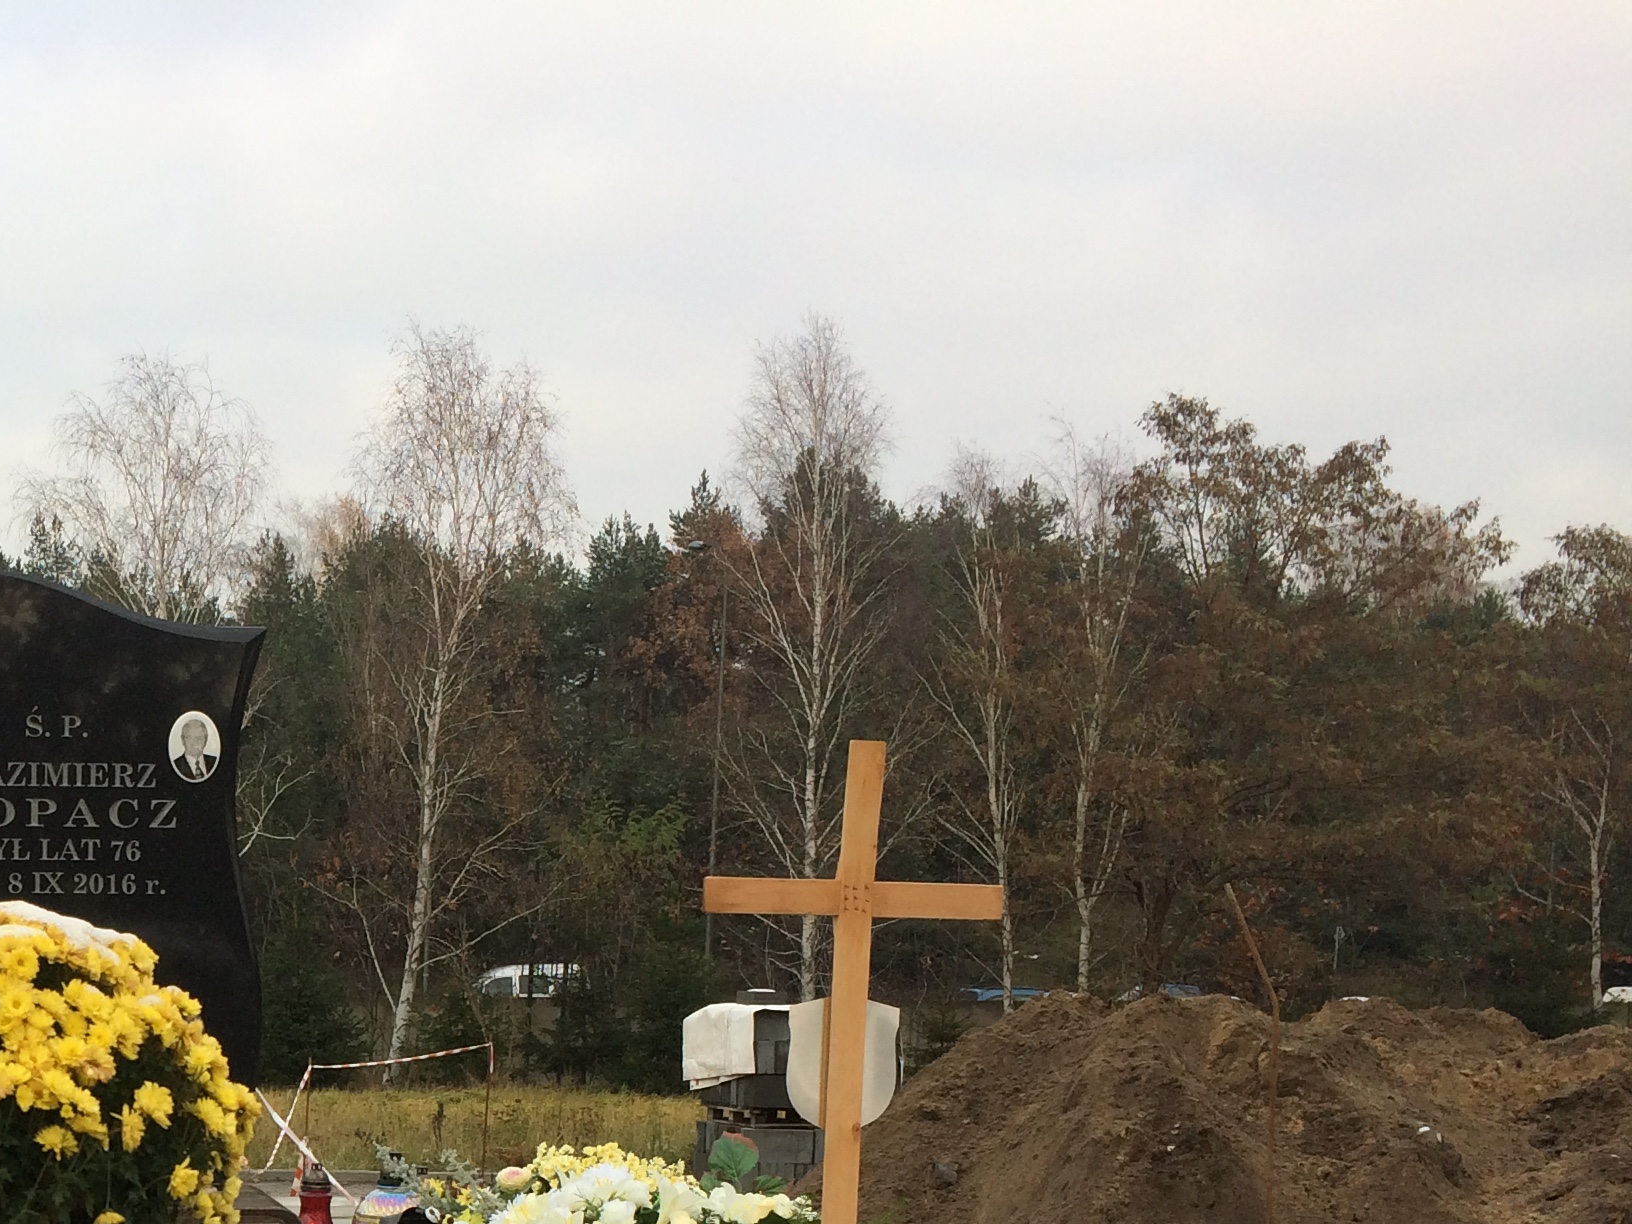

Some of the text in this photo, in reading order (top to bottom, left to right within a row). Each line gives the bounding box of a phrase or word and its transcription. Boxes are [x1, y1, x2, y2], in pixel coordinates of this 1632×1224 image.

[25, 705, 89, 738] Ś. P.
[39, 838, 101, 861] LAT
[110, 839, 142, 862] 76
[8, 872, 24, 894] 8
[31, 871, 65, 894] IX
[73, 873, 137, 895] 2016
[145, 879, 166, 895] r.
